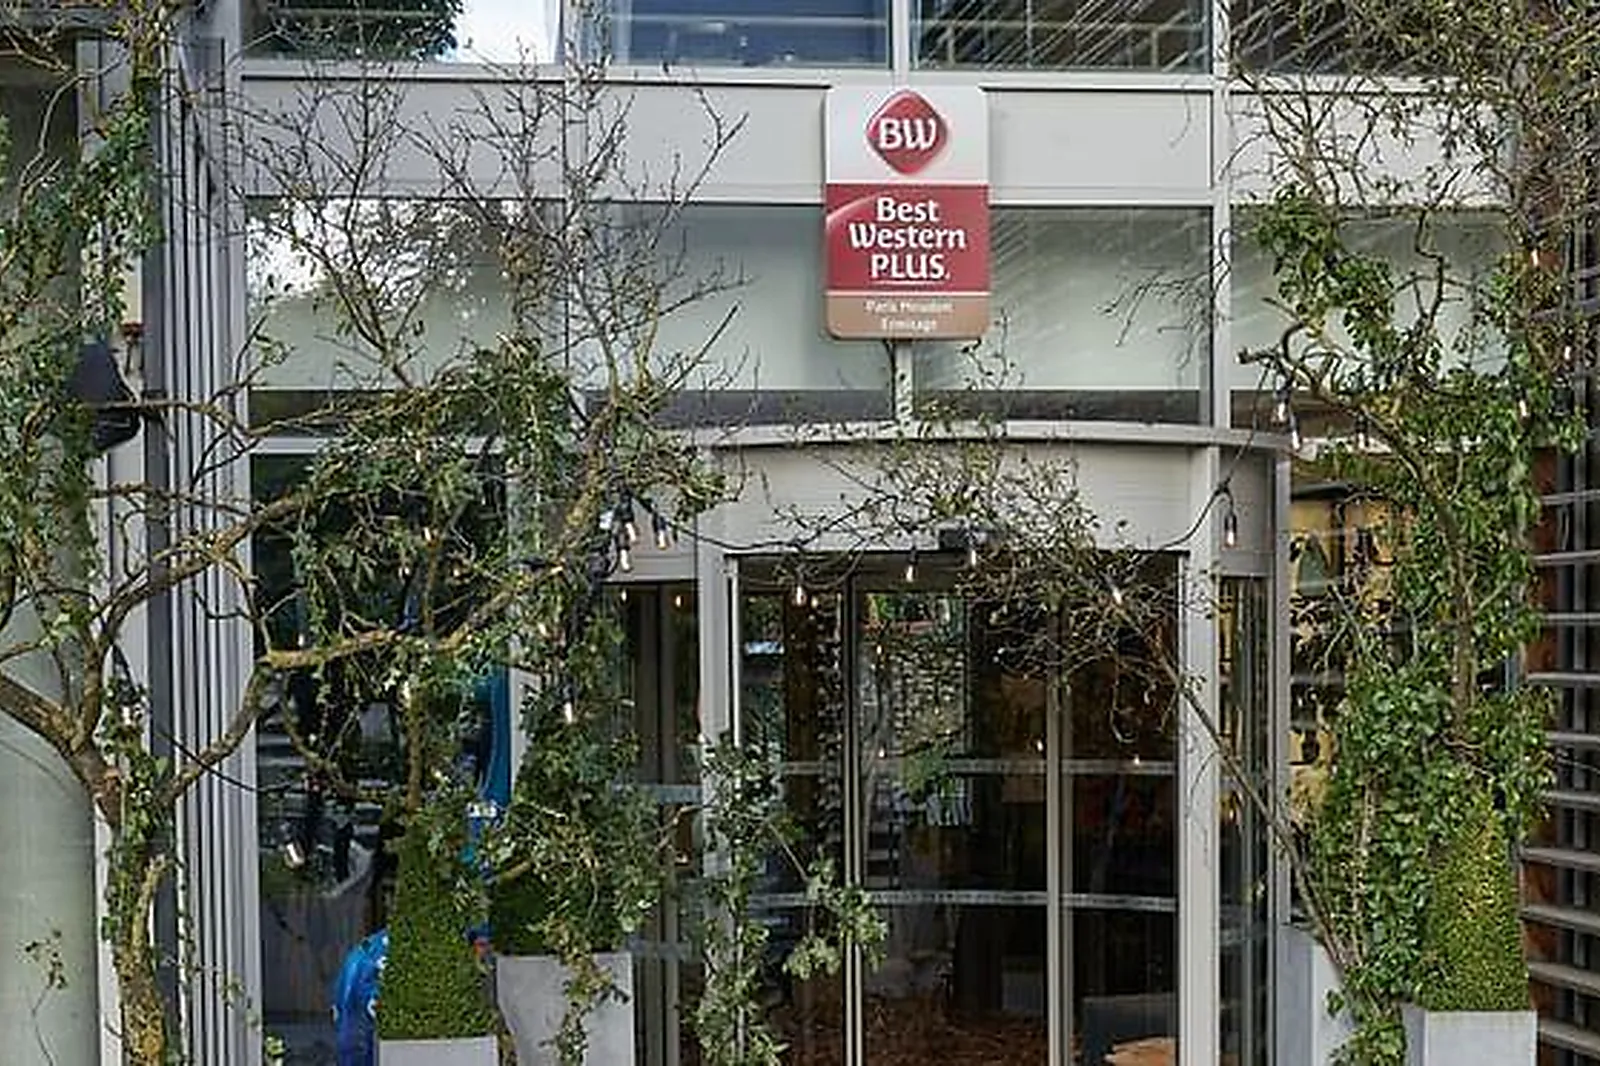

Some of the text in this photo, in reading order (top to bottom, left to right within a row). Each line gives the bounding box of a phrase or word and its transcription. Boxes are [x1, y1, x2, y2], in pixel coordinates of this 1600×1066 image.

[879, 118, 937, 150] BW
[877, 198, 939, 222] Best
[849, 223, 966, 249] Western
